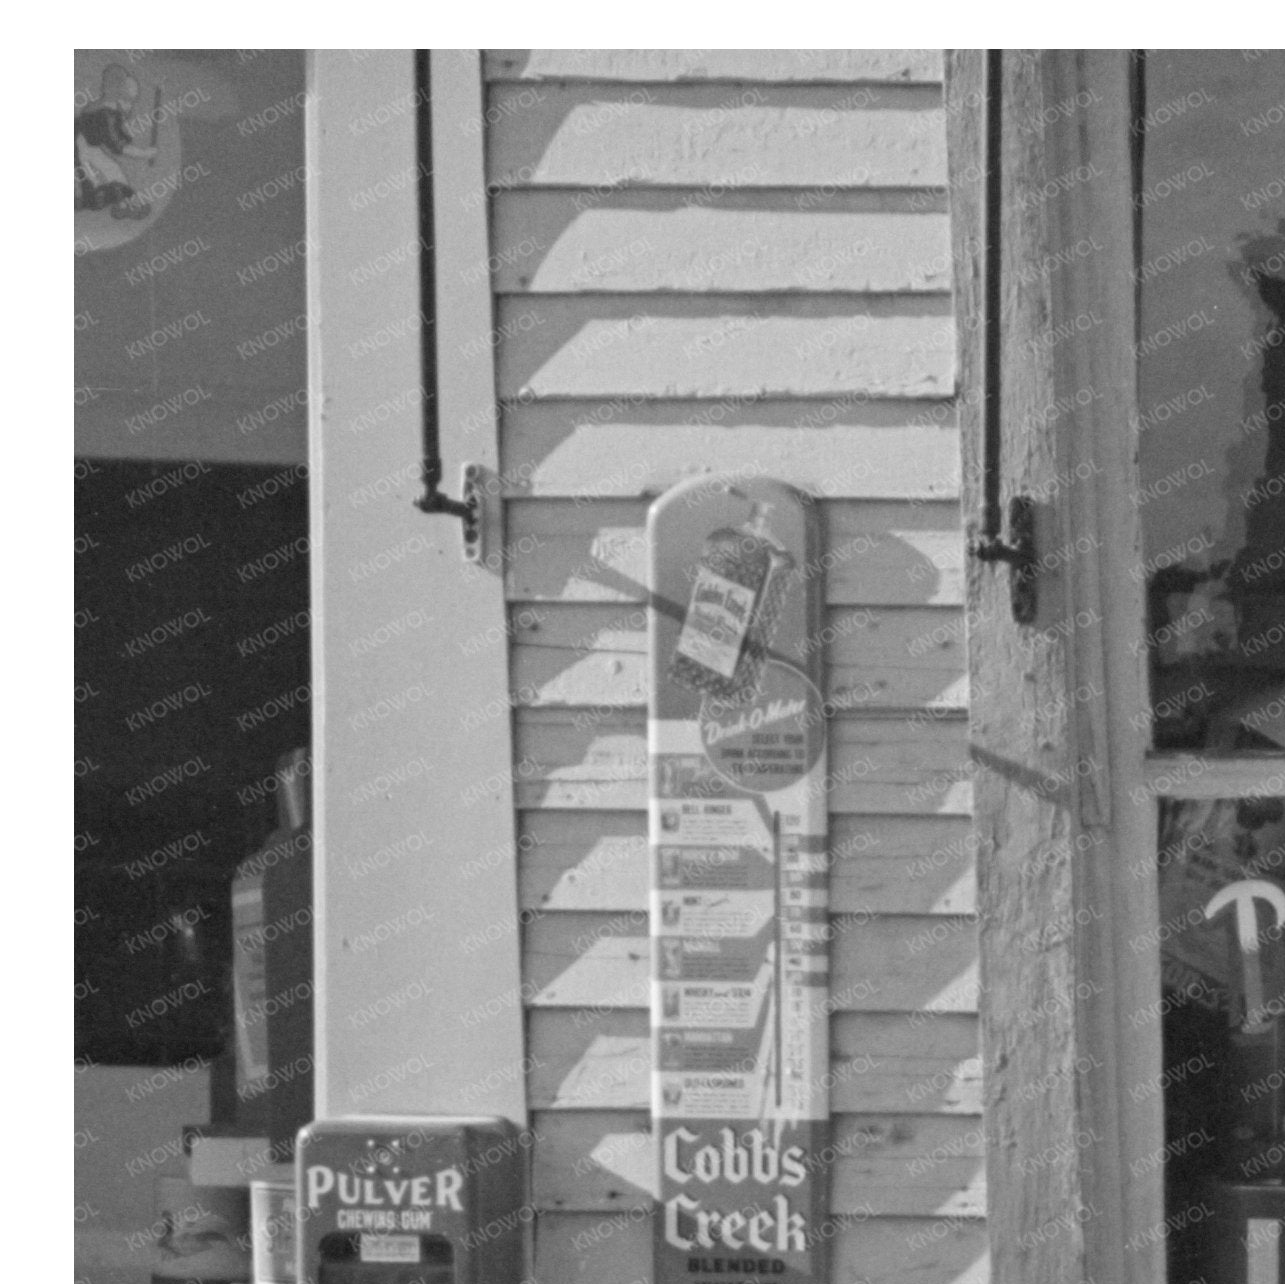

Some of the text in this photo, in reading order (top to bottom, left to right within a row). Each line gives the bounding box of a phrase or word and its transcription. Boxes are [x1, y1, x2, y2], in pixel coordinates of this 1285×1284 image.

[664, 1126, 806, 1186] Cobbs
[306, 1164, 464, 1212] PULVER
[336, 1209, 433, 1230] CHEWING GUM
[664, 1193, 806, 1253] Creek
[687, 1257, 786, 1275] BLENDED
